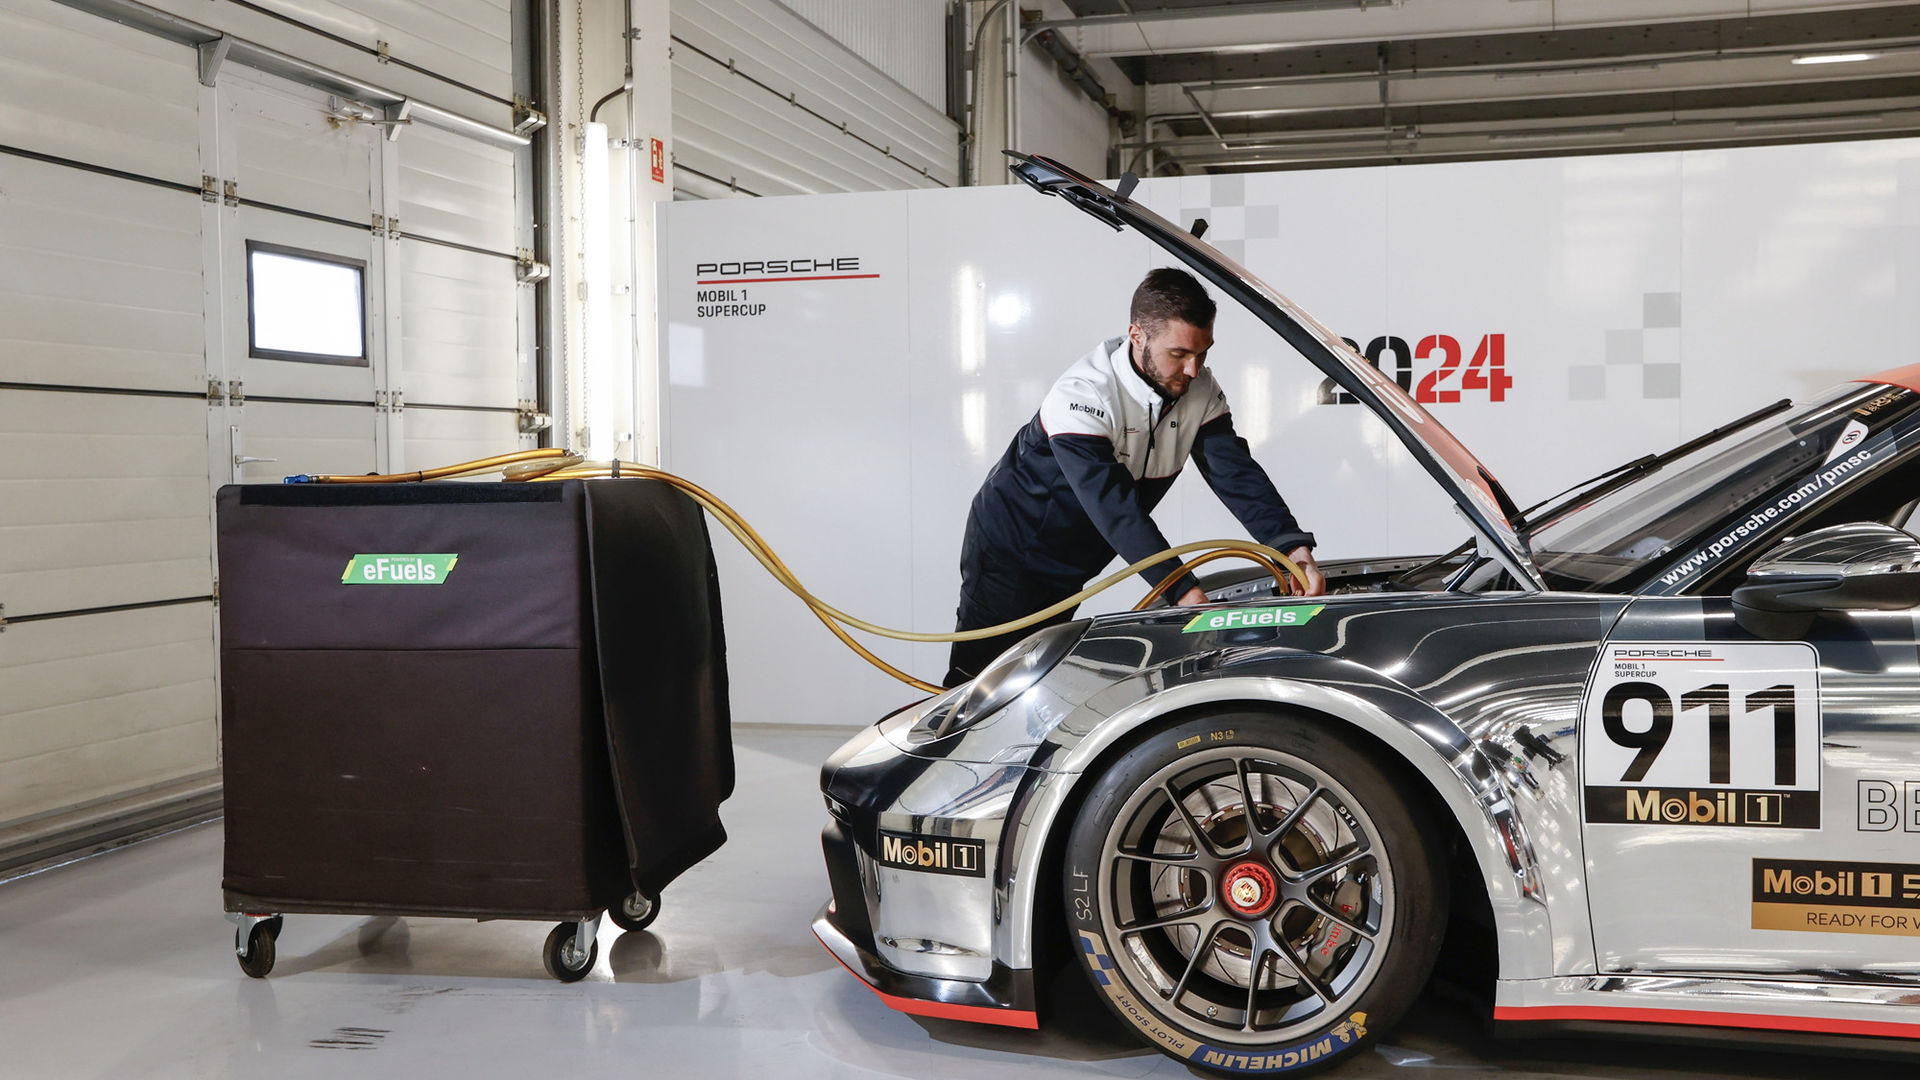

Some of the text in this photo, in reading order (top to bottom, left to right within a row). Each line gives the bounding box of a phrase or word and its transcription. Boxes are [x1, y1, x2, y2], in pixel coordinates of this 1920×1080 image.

[697, 257, 860, 276] PORSCHE
[697, 289, 748, 303] MOBIL 1
[697, 303, 767, 318] SUPERCUP
[1069, 403, 1096, 416] Mobil
[1660, 448, 1872, 587] www.porsche.com/pmsc
[363, 557, 436, 582] eFuels
[1210, 608, 1297, 628] eFuels
[1614, 649, 1712, 658] PORSCHE
[1210, 731, 1224, 741] N3
[1602, 681, 1796, 787] 911
[1338, 806, 1357, 827] 911
[1626, 789, 1736, 825] Mobil
[883, 836, 948, 869] Mobil
[1764, 869, 1854, 896] Mobil
[1321, 904, 1352, 956] bmbo
[1807, 913, 1867, 927] READY
[1871, 915, 1907, 930] FOR
[1115, 994, 1185, 1051] PILOT SPORT
[1203, 1037, 1333, 1071] MICHELIN
